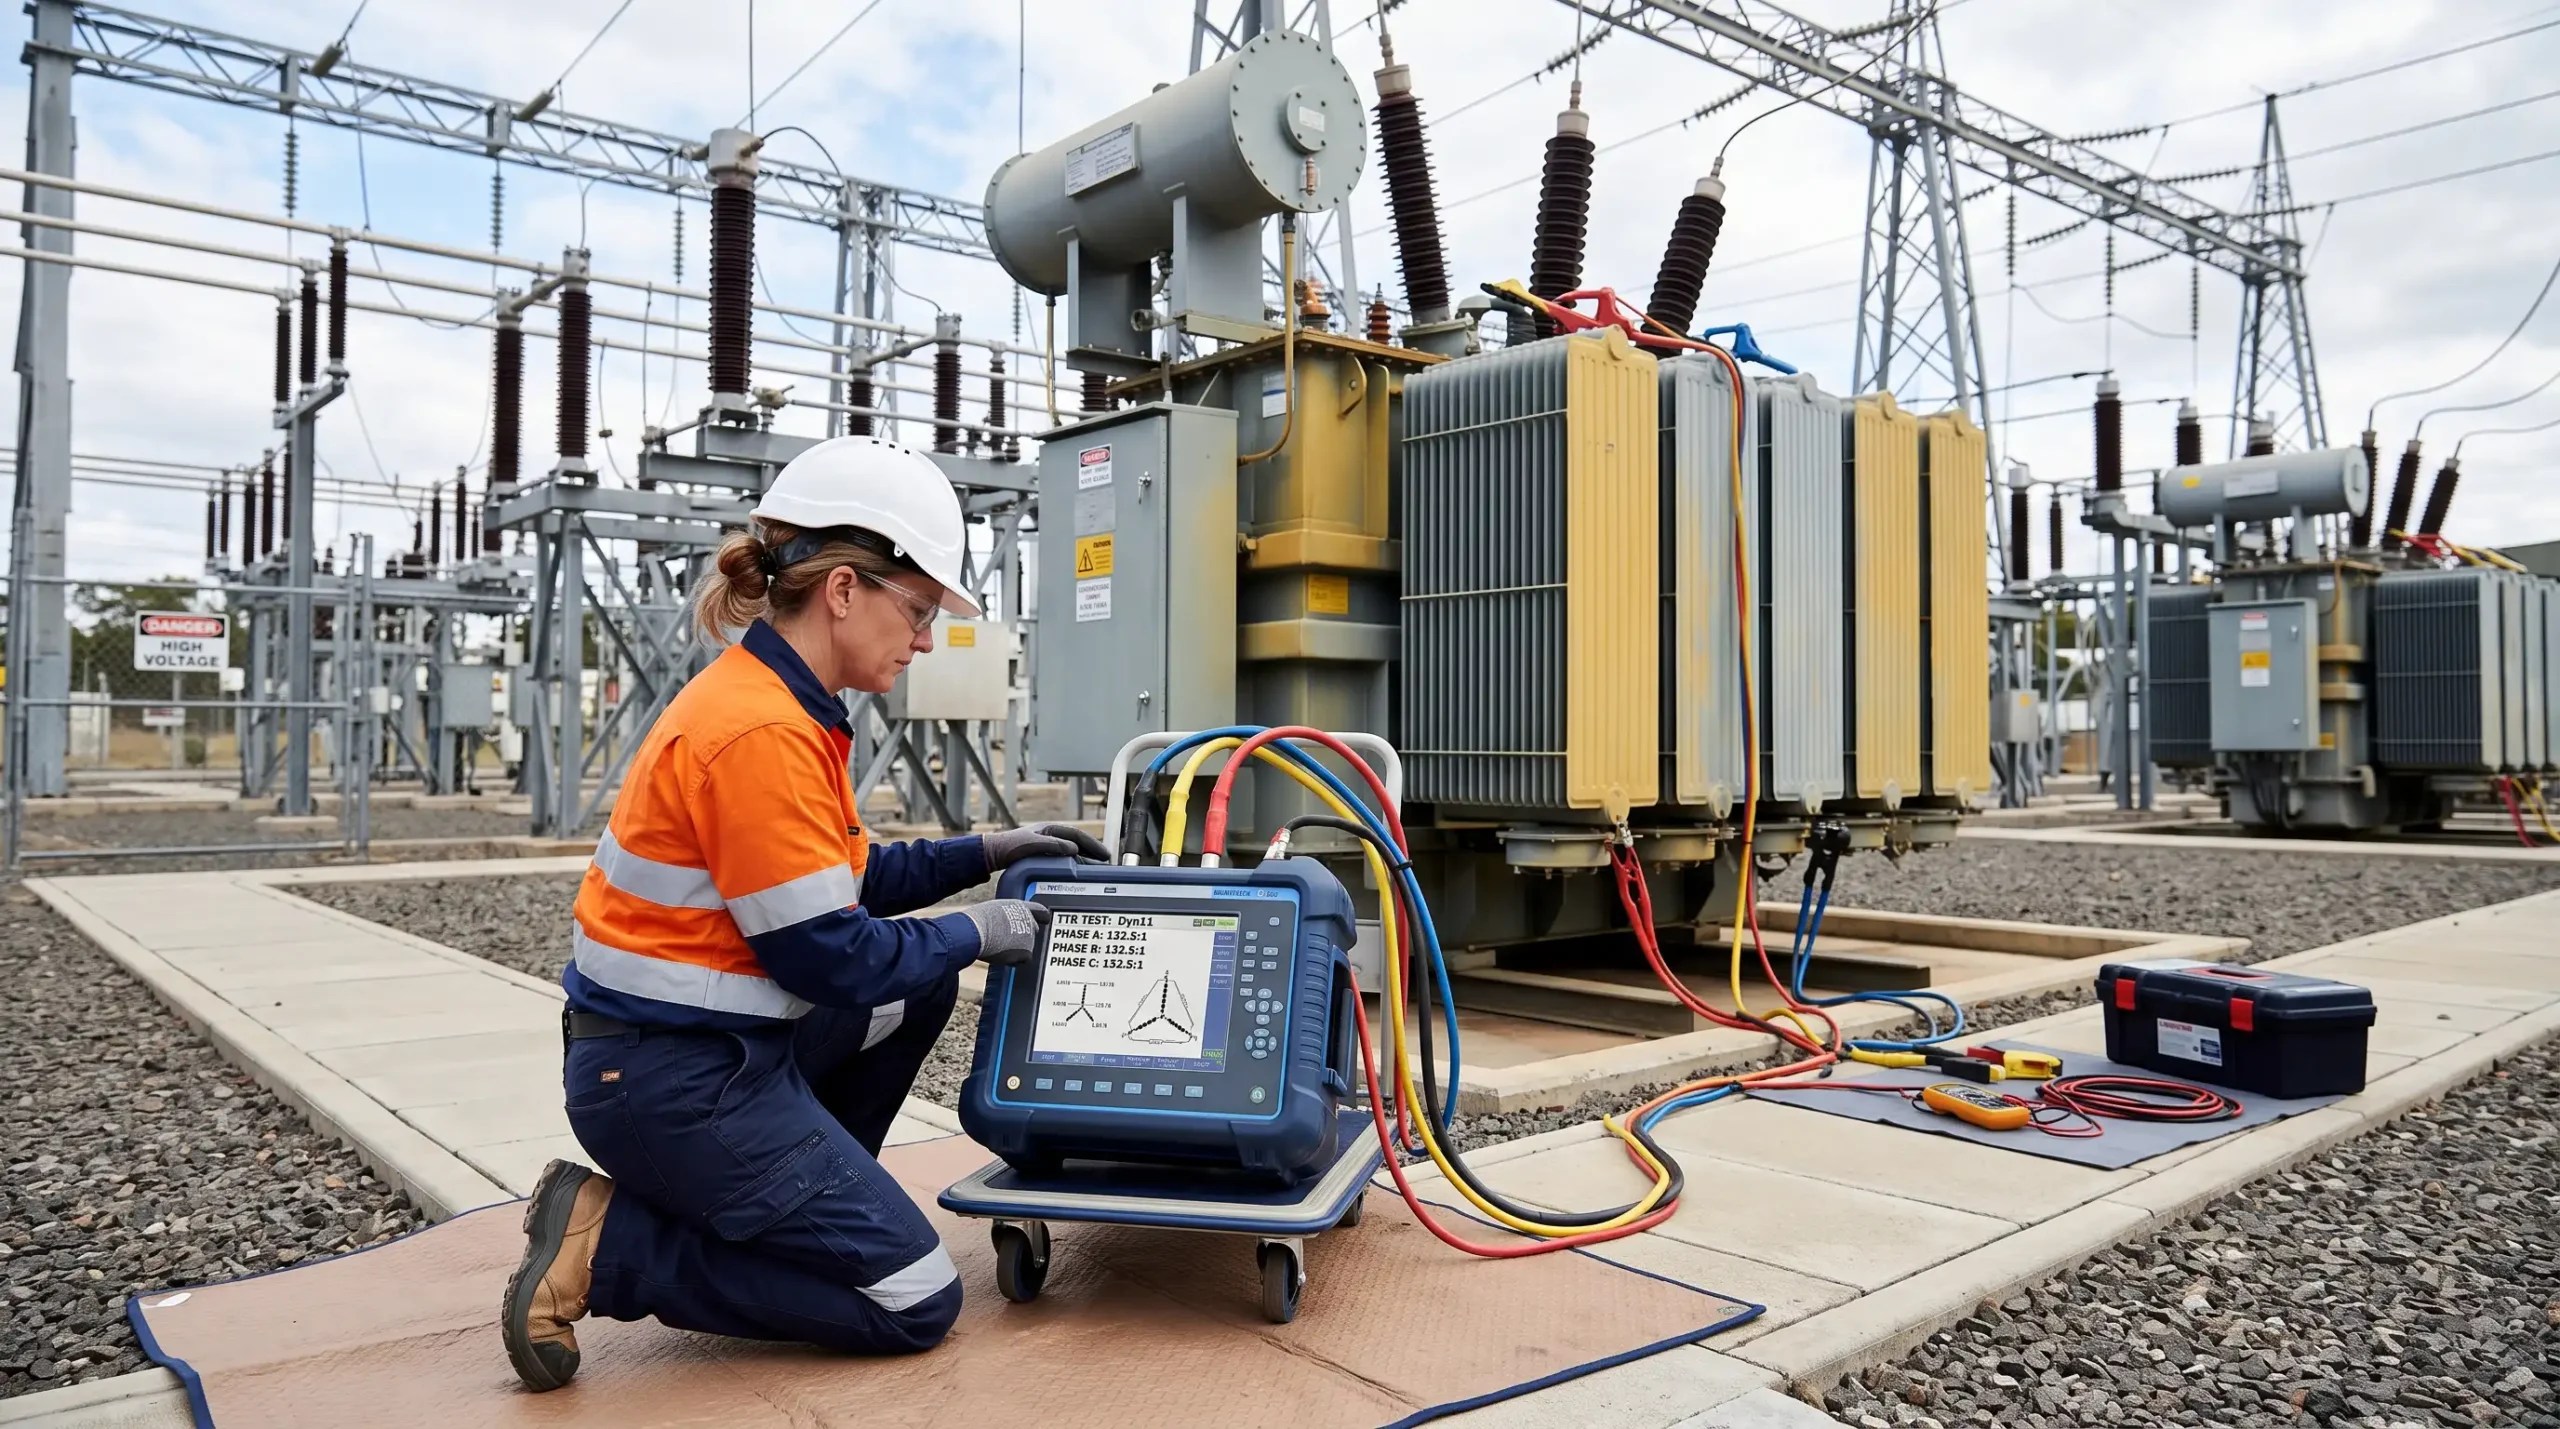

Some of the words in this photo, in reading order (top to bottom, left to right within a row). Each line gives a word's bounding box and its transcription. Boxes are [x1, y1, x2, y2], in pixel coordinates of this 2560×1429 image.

[161, 641, 202, 652] HIGH
[144, 655, 219, 667] VOLTAGE
[1057, 914, 1078, 924] TTR
[1081, 915, 1112, 925] TEST:
[1118, 916, 1153, 928] Dyn11
[1054, 929, 1090, 939] PHASE
[1092, 930, 1103, 940] A:
[1052, 943, 1088, 953] PHASE
[1050, 957, 1086, 967] PHASE
[1088, 958, 1099, 968] C:
